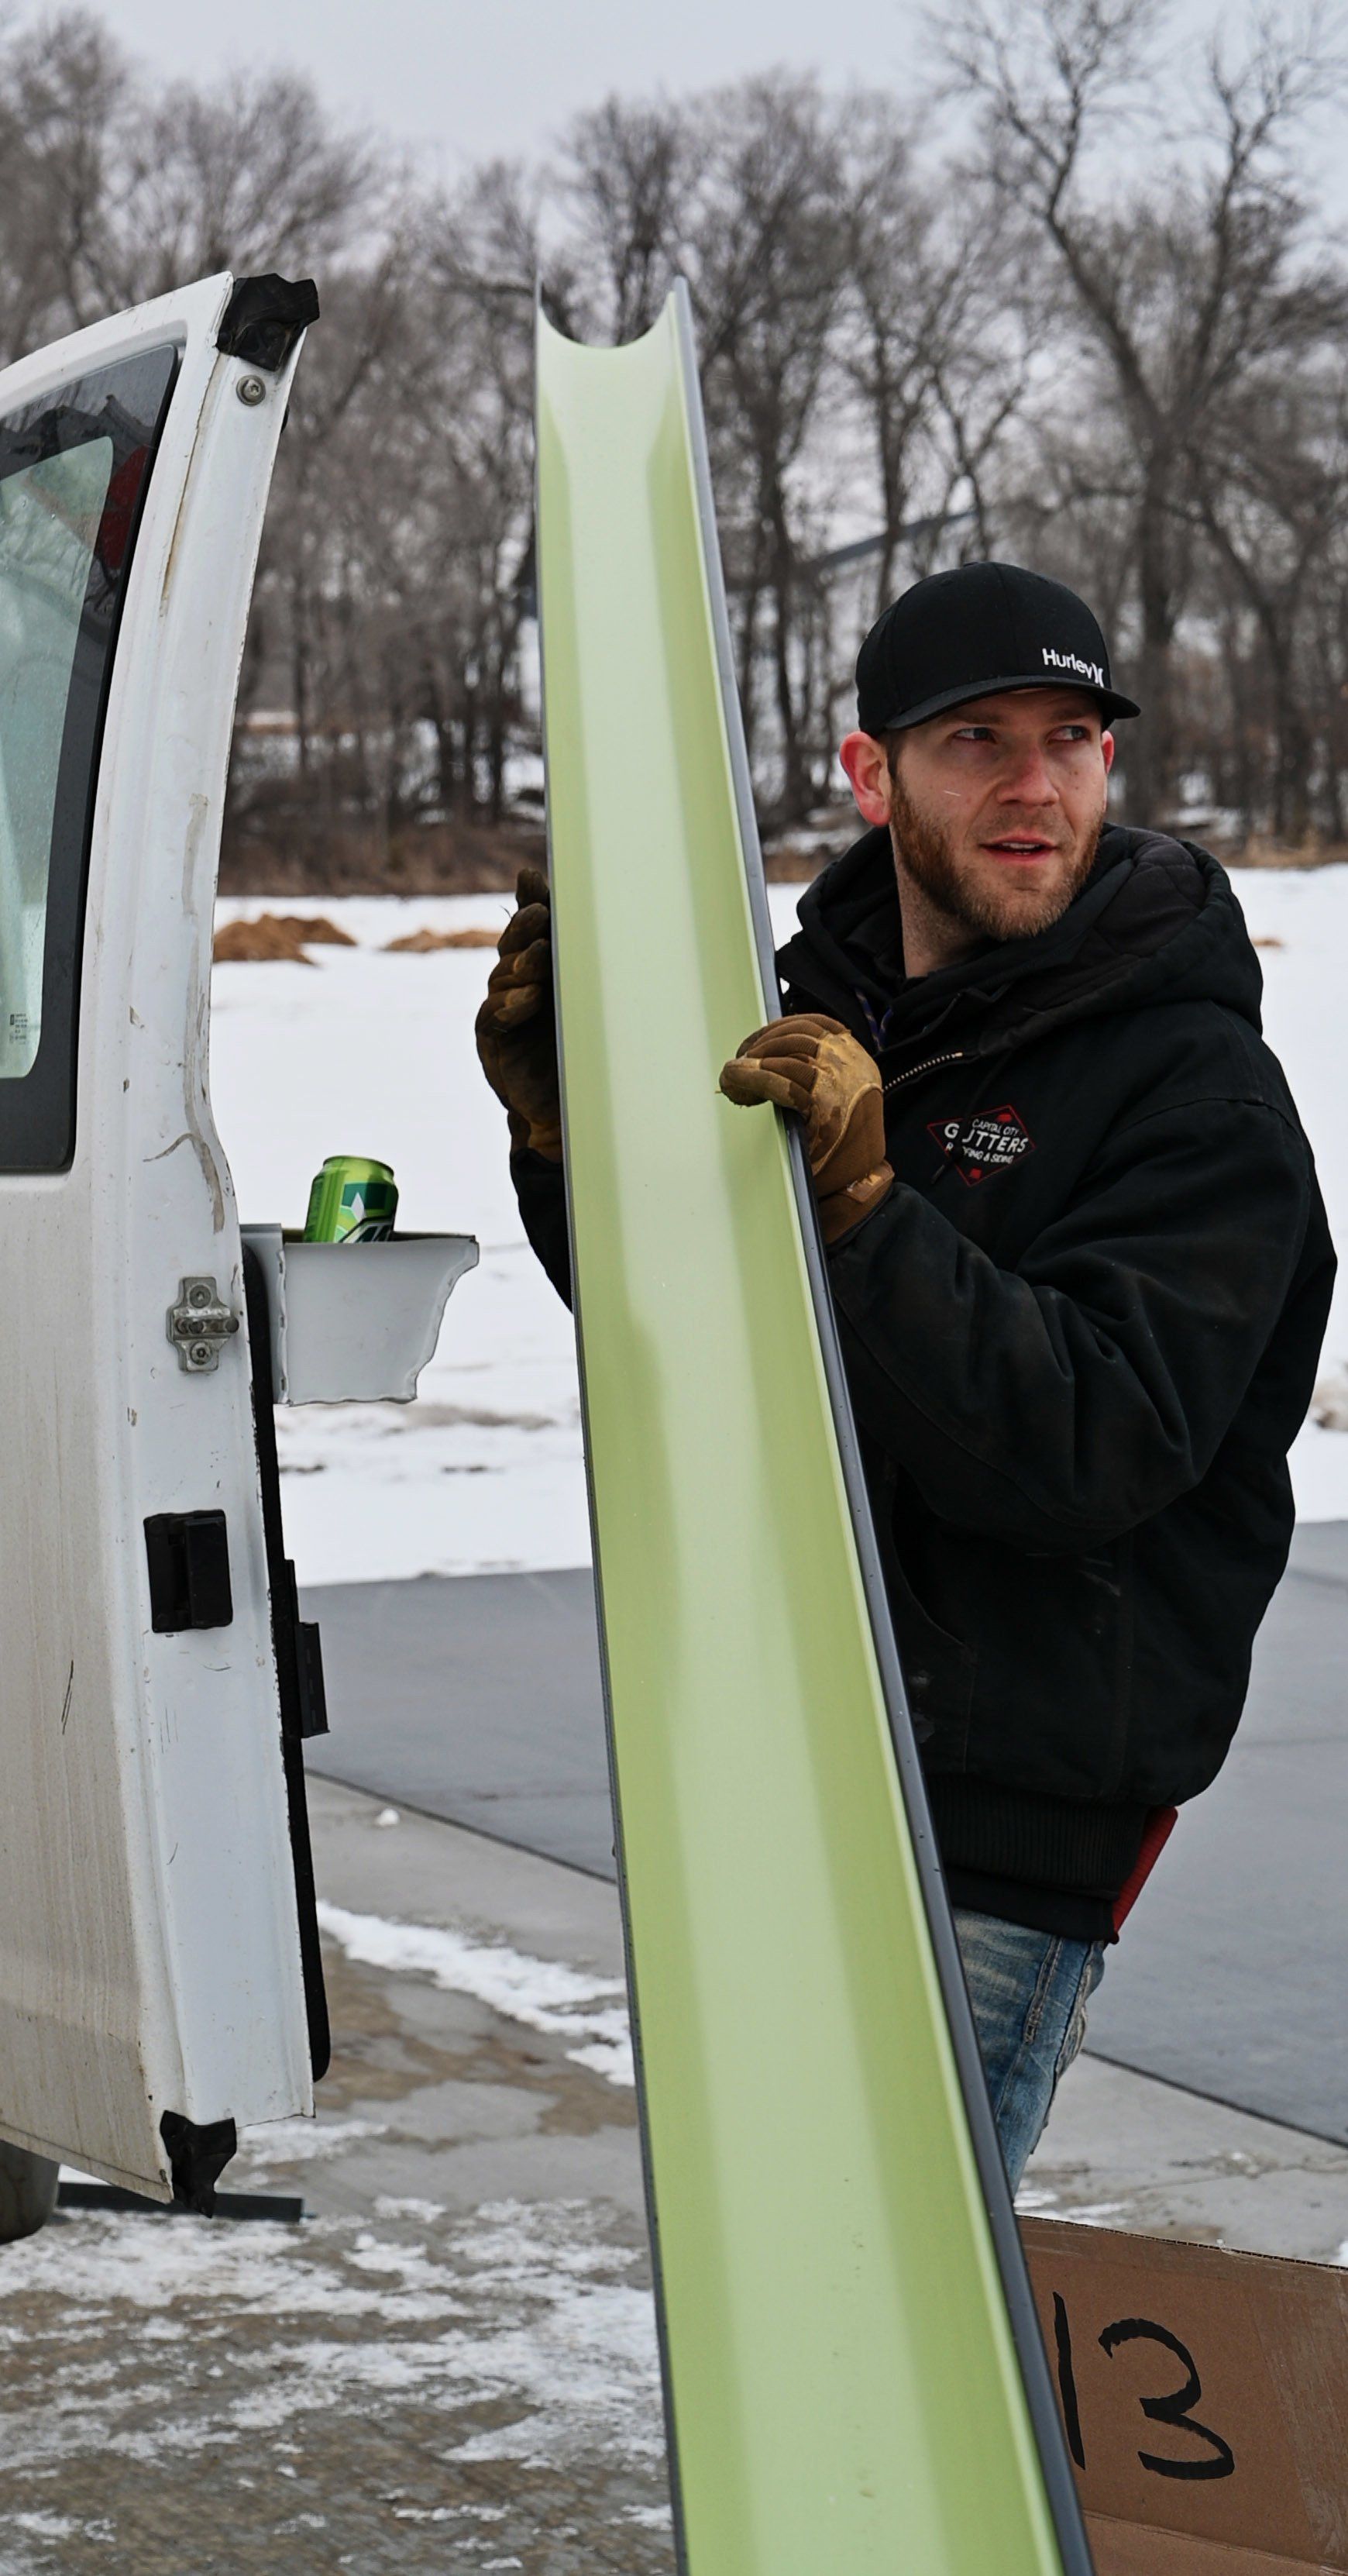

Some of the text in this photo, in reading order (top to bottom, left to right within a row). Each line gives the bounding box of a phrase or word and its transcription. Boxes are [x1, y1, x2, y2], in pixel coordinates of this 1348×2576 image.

[1041, 648, 1092, 680] Hurley
[972, 1118, 1020, 1136] CAPITAL CITY
[945, 1142, 984, 1160] RFING
[990, 1153, 1014, 1164] SIDING
[1053, 2292, 1235, 2480] 13
